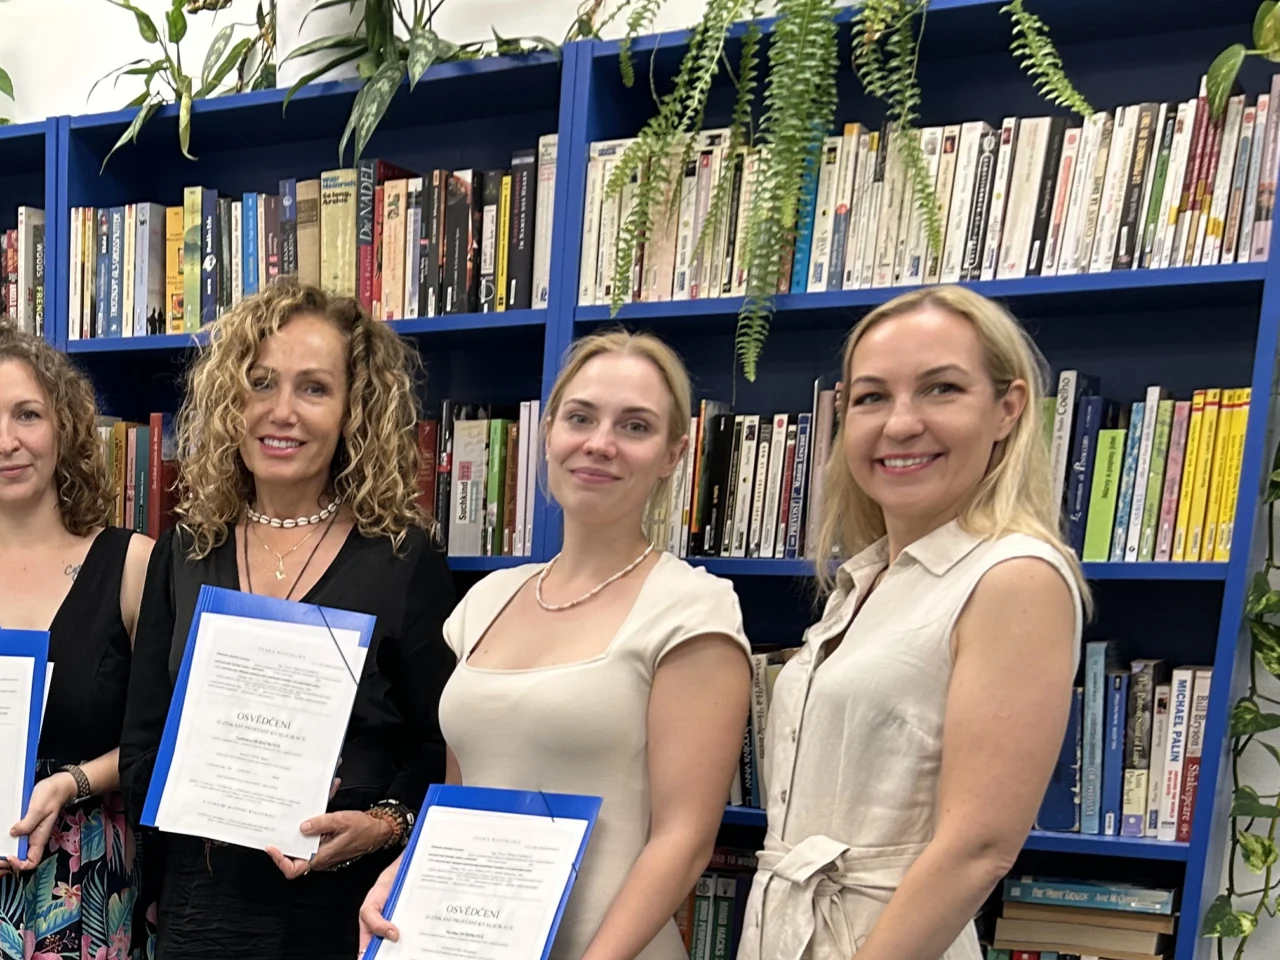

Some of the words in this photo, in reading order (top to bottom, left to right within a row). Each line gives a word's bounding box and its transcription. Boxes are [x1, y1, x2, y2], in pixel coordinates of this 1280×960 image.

[360, 163, 373, 218] NADEL
[360, 220, 372, 241] Die
[1056, 377, 1071, 416] Coelho
[795, 433, 806, 461] Lescaut
[460, 464, 470, 480] 312
[793, 462, 802, 489] Manon
[458, 481, 469, 521] Suchkind
[1173, 679, 1188, 728] MICHAEL
[1196, 695, 1209, 712] Bill
[237, 711, 292, 730] OSVĚDČENÍ
[1191, 713, 1207, 748] Bryson
[1169, 731, 1183, 762] PALIN
[1135, 771, 1144, 788] Ann
[1181, 764, 1197, 821] Shakespeare
[1085, 785, 1094, 817] HOUSE
[446, 904, 501, 919] OSVĚDČENÍ
[699, 900, 708, 920] MIND
[719, 901, 728, 924] MIND
[715, 927, 726, 956] HACKS
